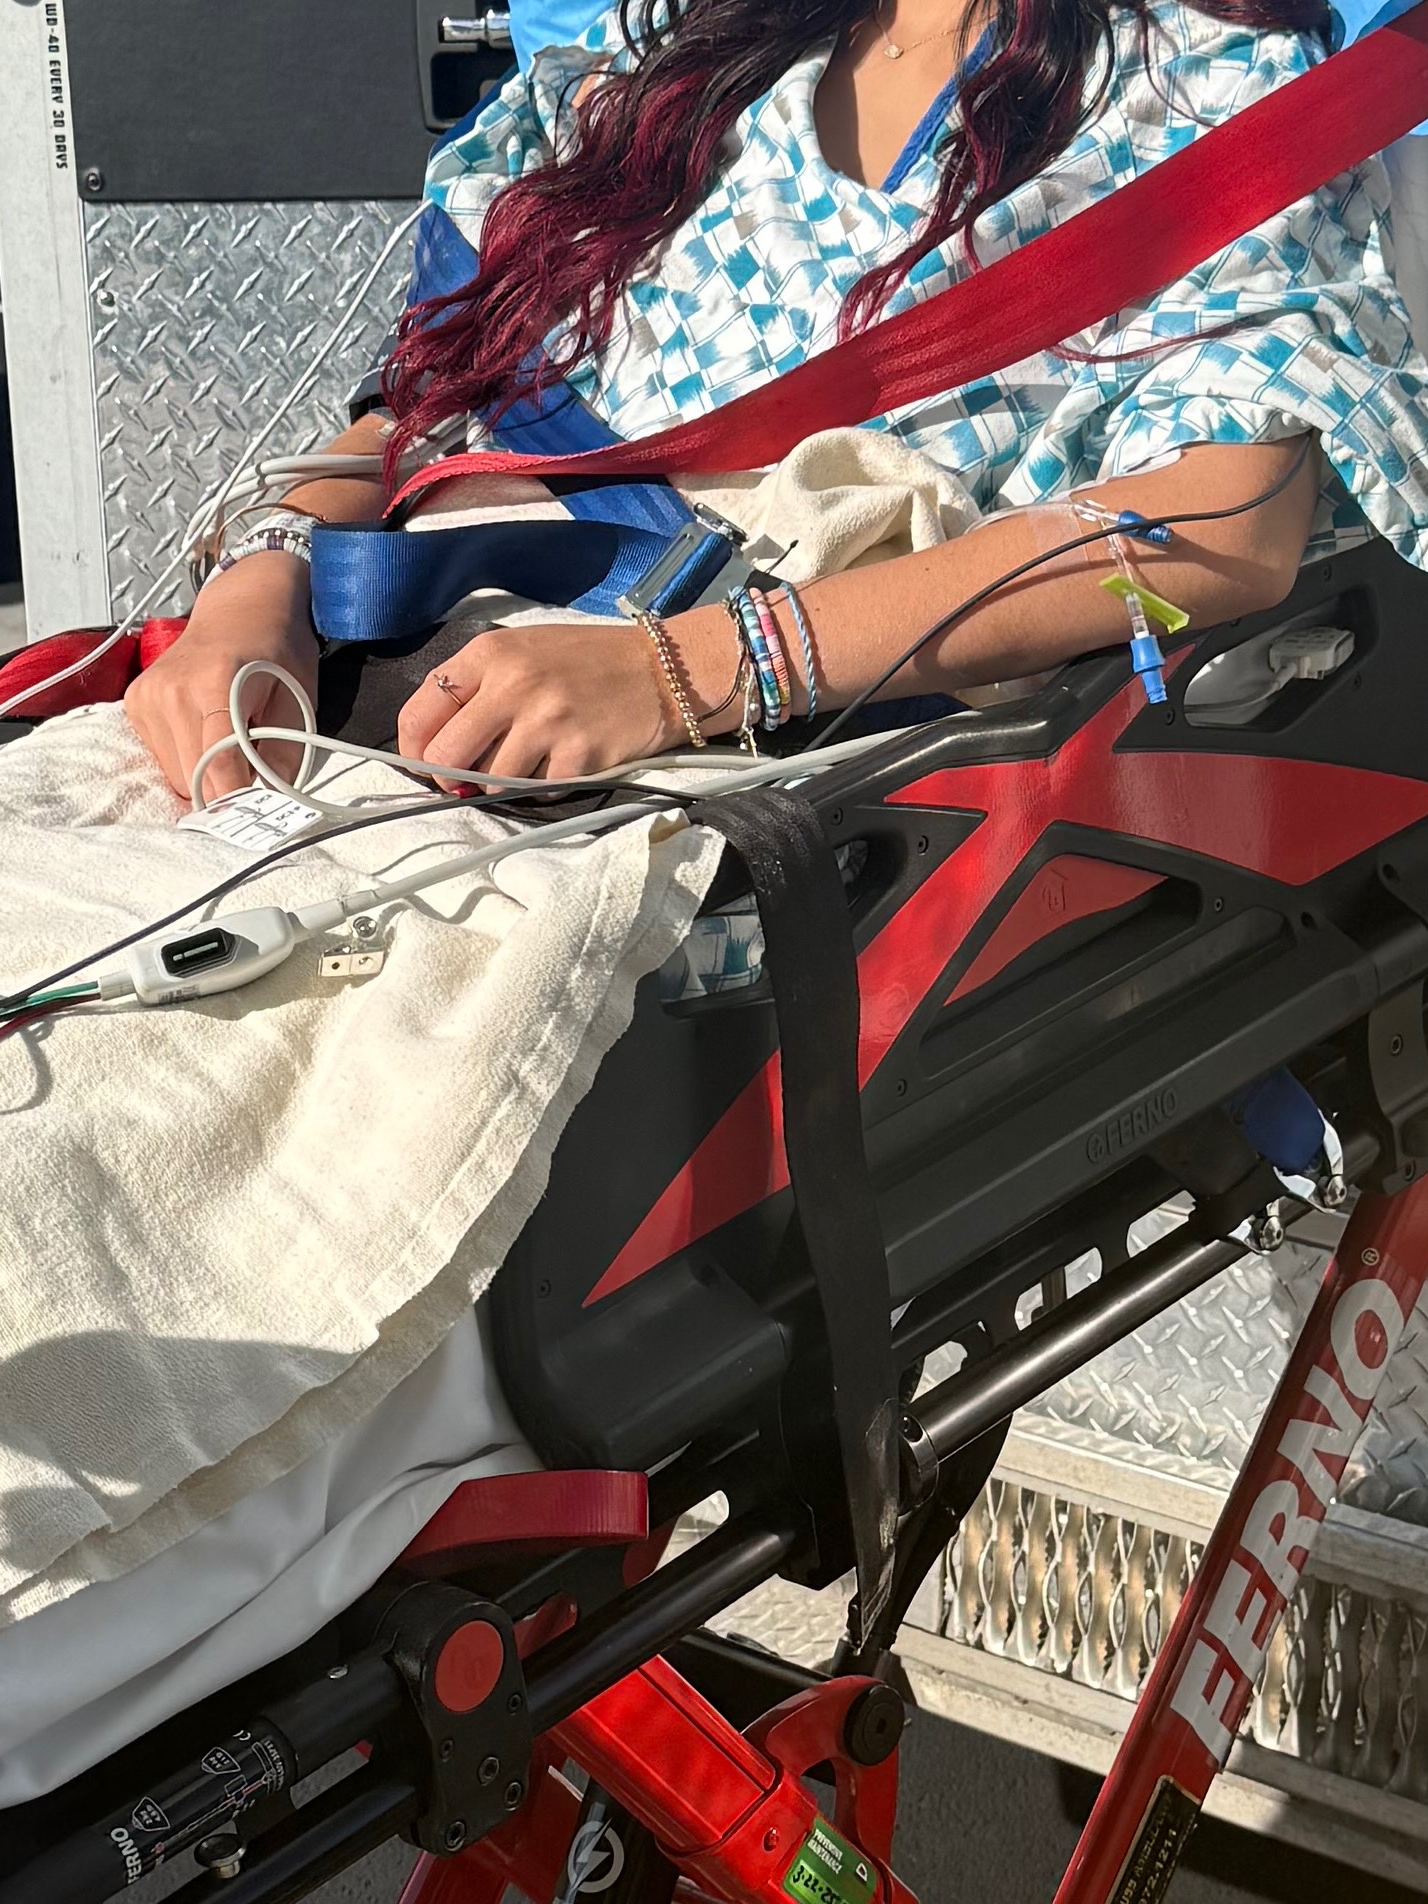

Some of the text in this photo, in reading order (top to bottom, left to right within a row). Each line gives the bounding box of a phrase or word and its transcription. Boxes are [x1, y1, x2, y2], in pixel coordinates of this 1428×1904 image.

[45, 3, 60, 53] WD-40
[49, 60, 64, 104] EVERY
[53, 110, 66, 128] 30
[55, 135, 68, 169] DAYS
[1169, 1277, 1406, 1767] FERNO
